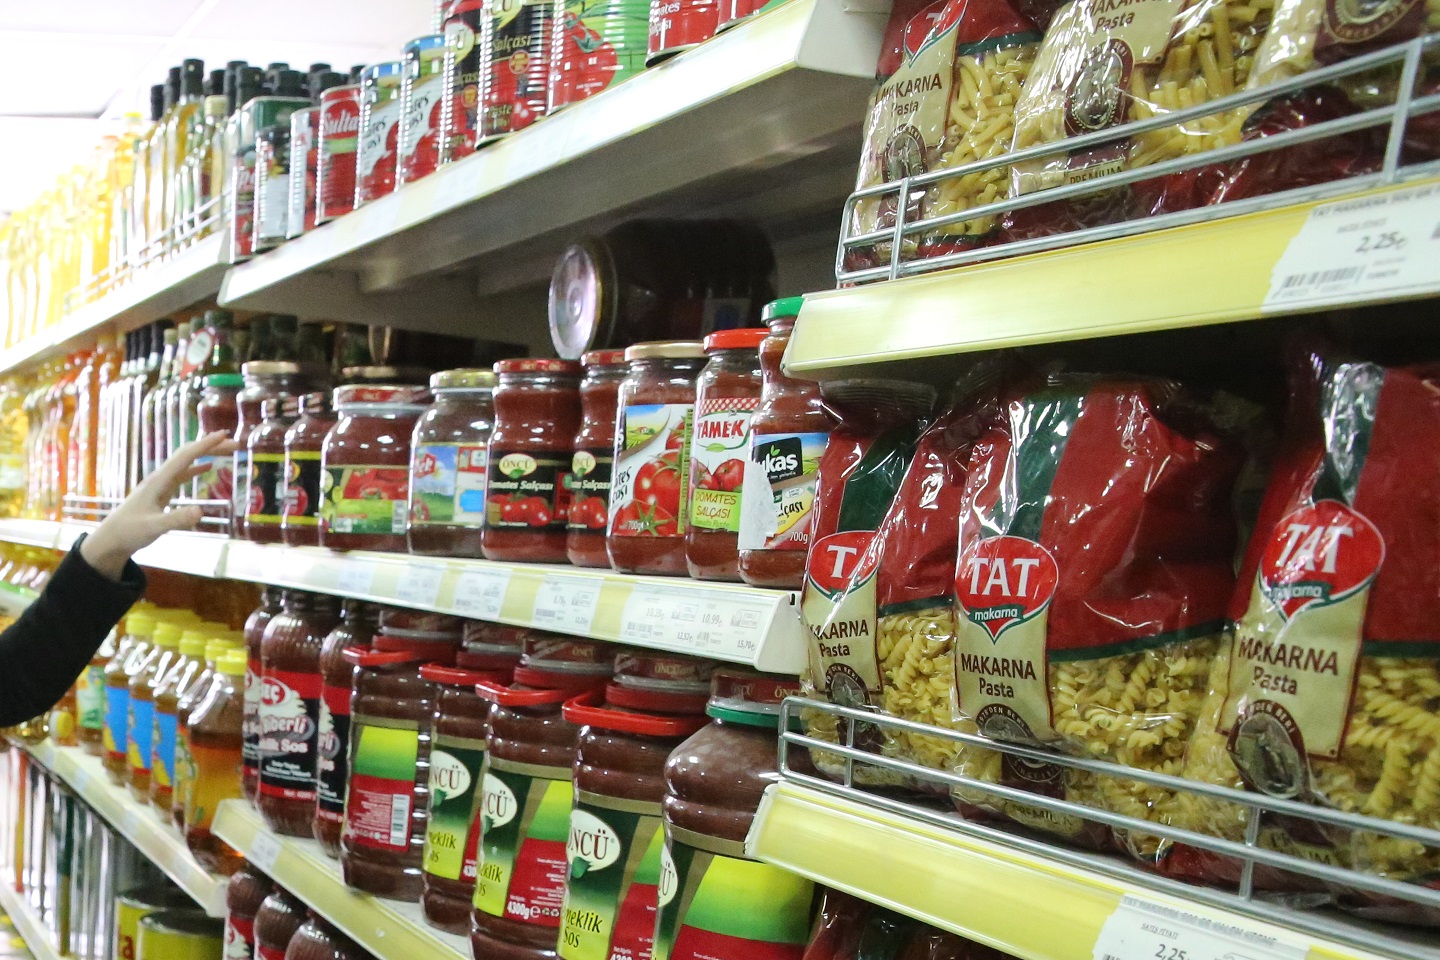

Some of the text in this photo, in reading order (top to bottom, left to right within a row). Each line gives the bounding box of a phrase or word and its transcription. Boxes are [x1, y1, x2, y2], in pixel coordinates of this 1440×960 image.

[1095, 11, 1136, 34] Pasta
[891, 100, 919, 118] Pasta
[324, 108, 360, 134] Sulta
[697, 419, 745, 440] TAMEK
[502, 459, 533, 473] ÖNCÜ
[760, 453, 799, 476] kaş
[489, 480, 554, 491] omates Salçası
[695, 491, 738, 505] DOMATES
[696, 505, 732, 519] SALÇASI
[789, 531, 809, 544] 700g
[1275, 523, 1354, 574] TAT
[966, 557, 1040, 597] TAT
[974, 607, 1018, 622] makarna
[819, 642, 851, 657] Pasta
[1238, 635, 1340, 677] MAKARNA
[961, 653, 1037, 681] MAKARNA
[978, 677, 1015, 699] Pasta
[1253, 666, 1299, 696] Pasta
[431, 763, 462, 791] NCÜ
[485, 788, 508, 820] CÜ
[507, 900, 532, 920] 4300g
[564, 926, 581, 949] Sos
